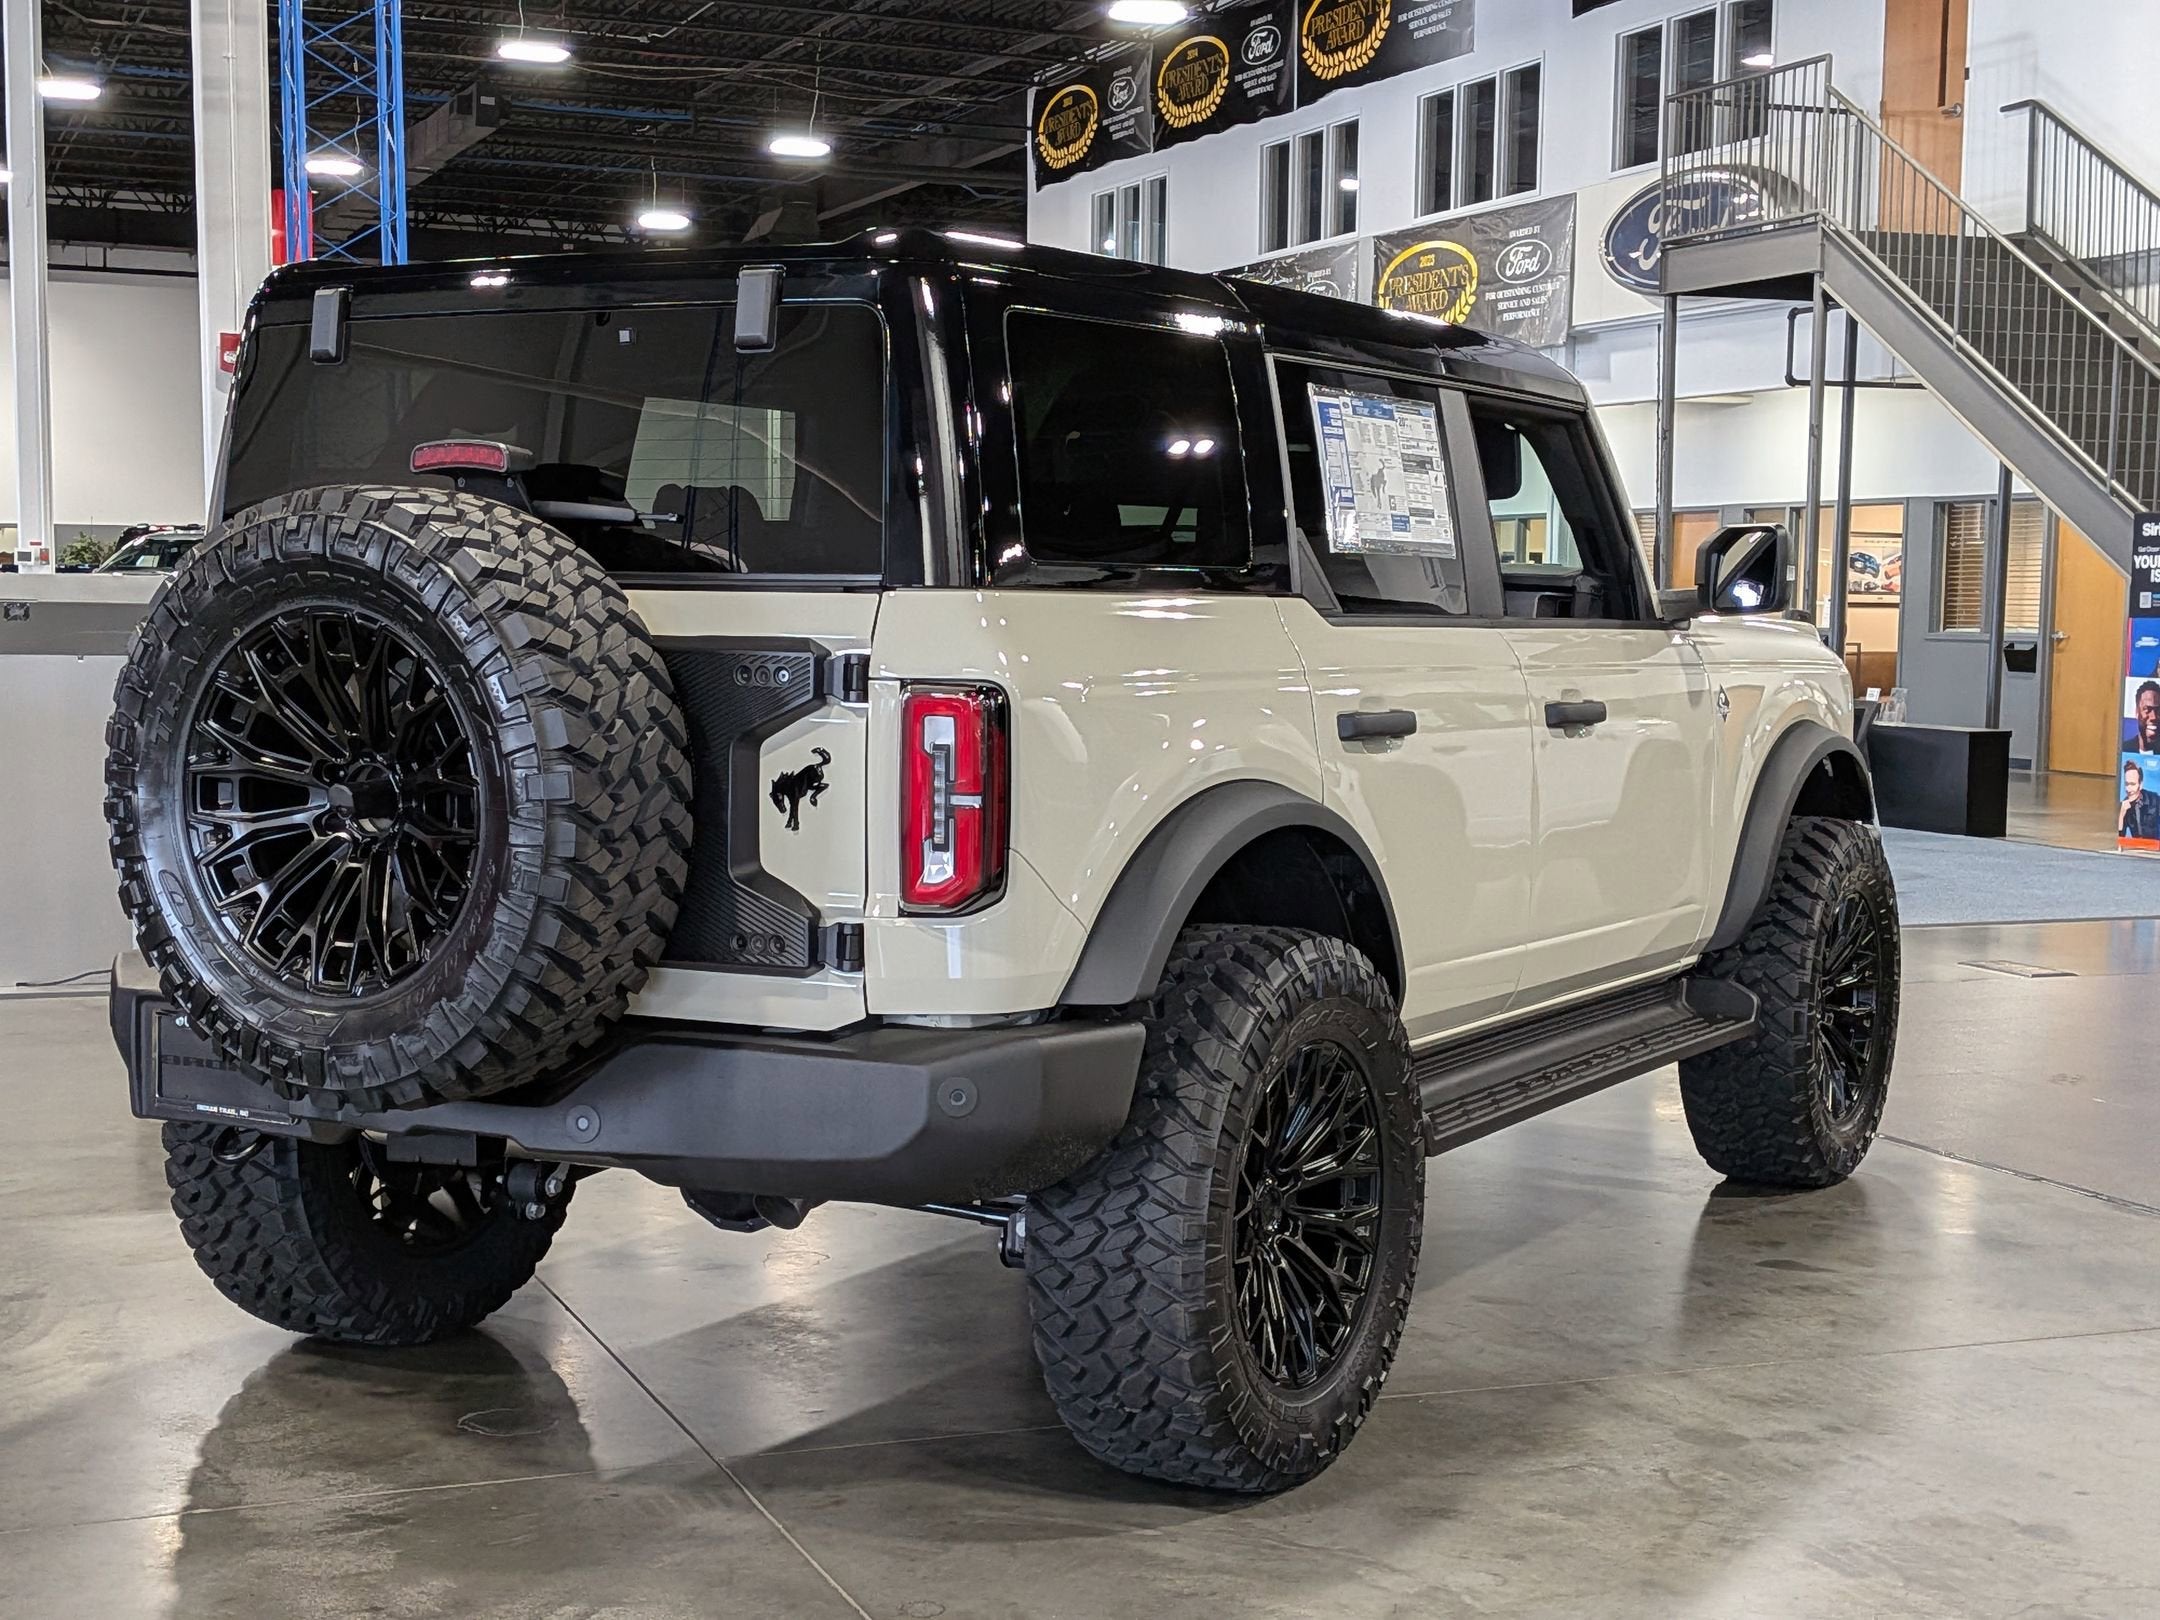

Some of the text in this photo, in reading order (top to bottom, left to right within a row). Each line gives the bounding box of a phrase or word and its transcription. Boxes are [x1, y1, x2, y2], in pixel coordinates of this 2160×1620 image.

[1311, 0, 1382, 37] PRESIDENTS
[1248, 31, 1274, 60] Ford
[1325, 20, 1366, 51] AWARD
[1505, 245, 1541, 277] Ford
[1388, 264, 1469, 298] PRESIDENT'S
[1406, 289, 1449, 312] AWARD
[2133, 554, 2160, 569] YOU
